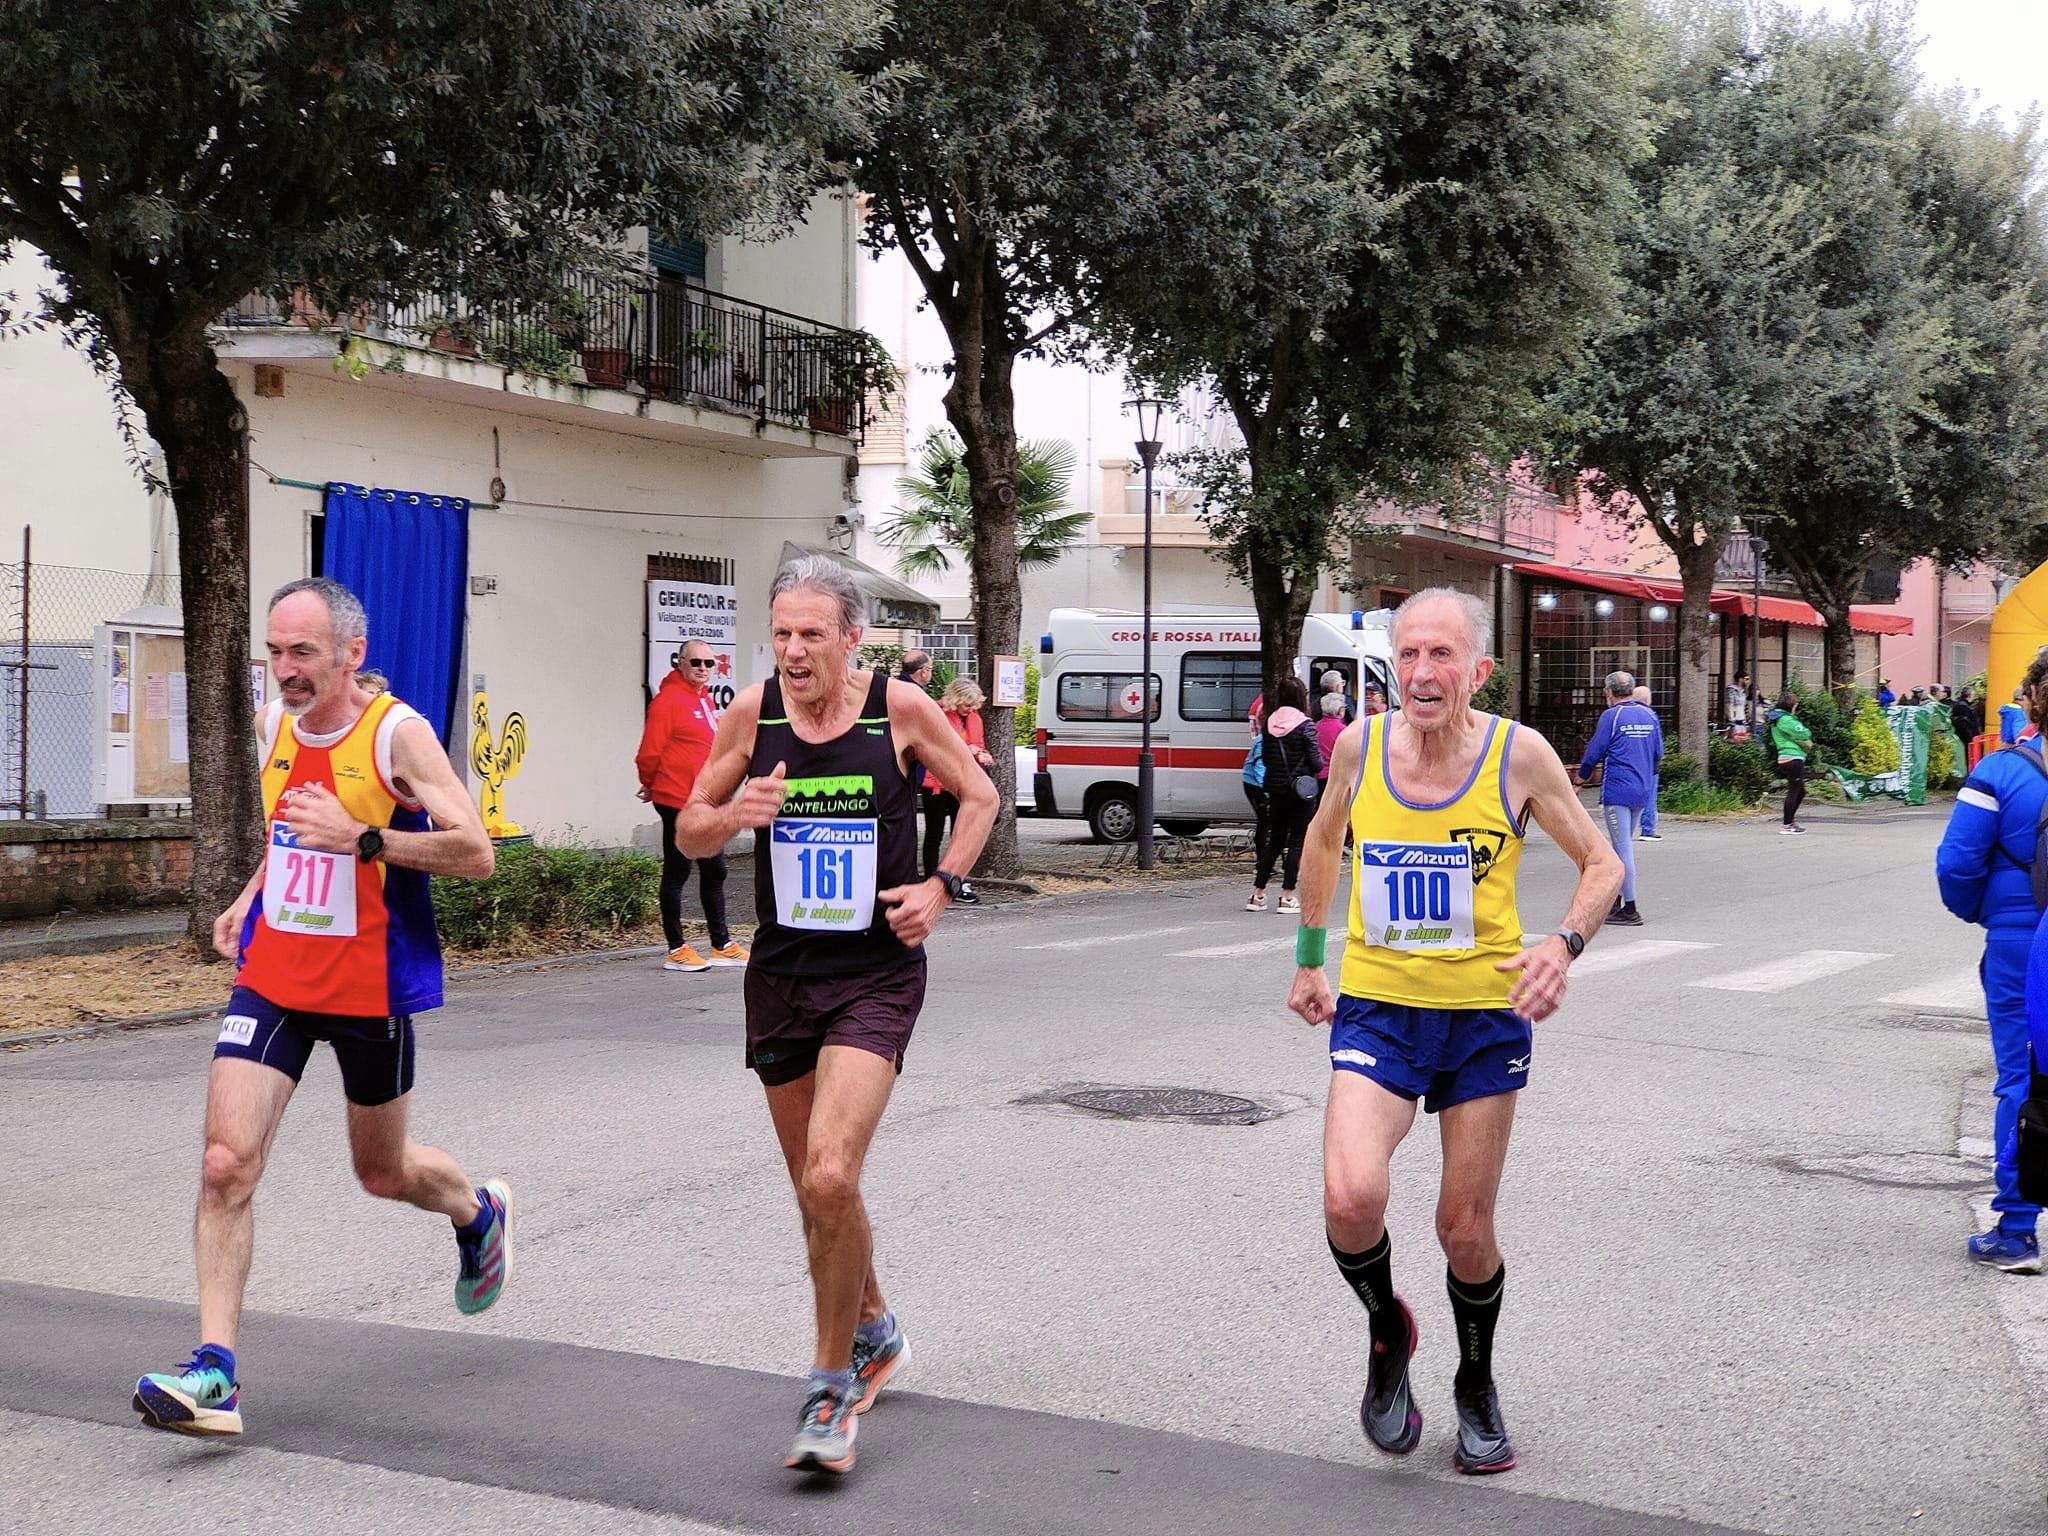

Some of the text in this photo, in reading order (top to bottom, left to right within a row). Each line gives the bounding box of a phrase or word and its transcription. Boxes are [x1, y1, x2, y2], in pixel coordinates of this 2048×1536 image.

[1111, 631, 1159, 642] CROE
[1164, 631, 1214, 642] ROSSA
[778, 798, 869, 815] ONTELUNGO
[284, 852, 335, 907] 217
[797, 848, 853, 900] 161
[1383, 870, 1451, 922] 100
